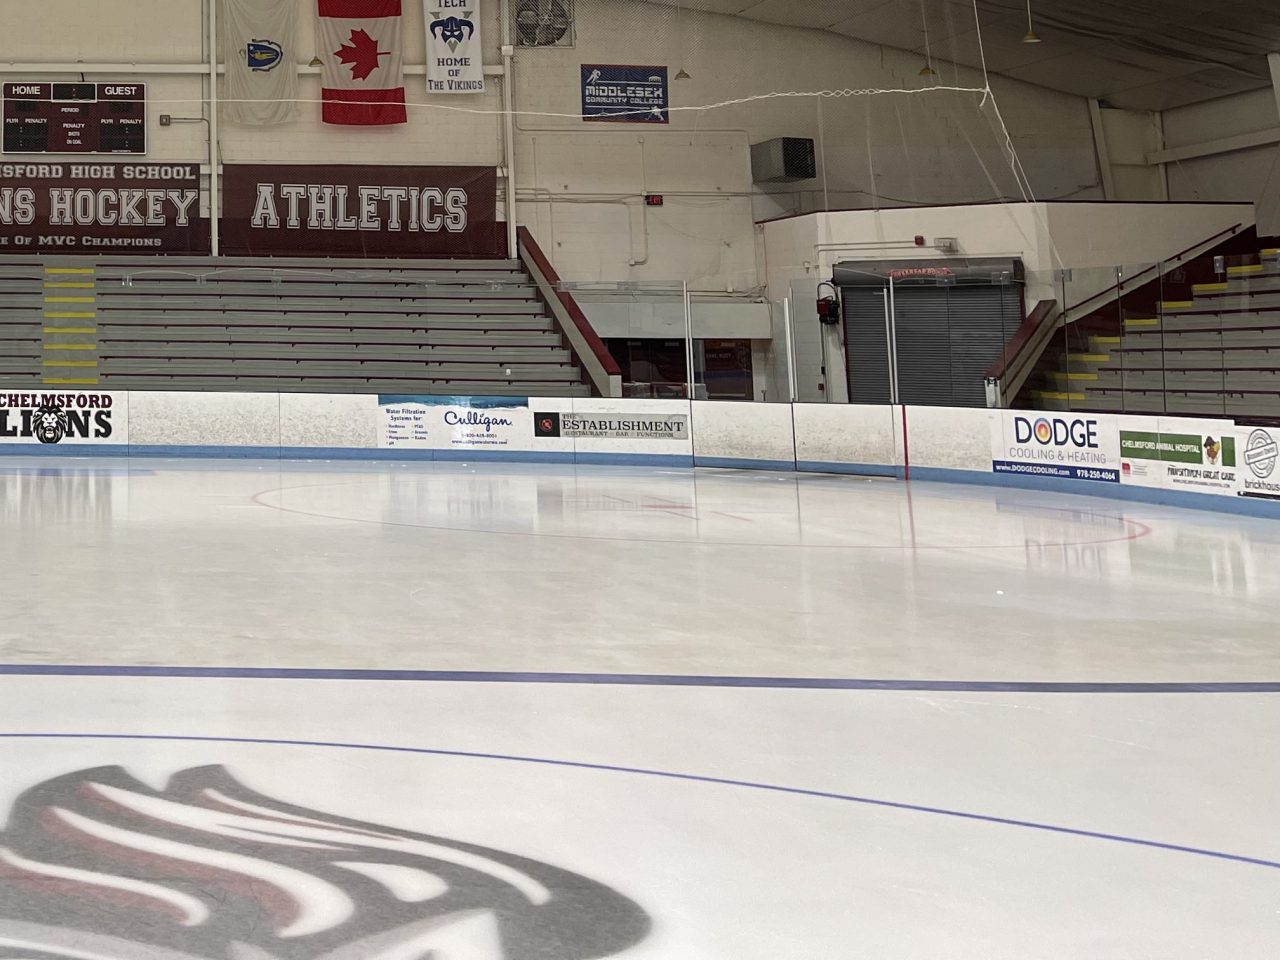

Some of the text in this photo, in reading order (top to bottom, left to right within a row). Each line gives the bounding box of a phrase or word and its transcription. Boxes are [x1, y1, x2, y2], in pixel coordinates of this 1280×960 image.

[437, 57, 471, 67] HOME
[448, 69, 460, 77] OF
[12, 86, 41, 96] HOME
[105, 86, 137, 96] GUEST
[70, 165, 116, 179] HIGH
[122, 166, 197, 180] SCHOOL
[49, 187, 199, 227] HOCKEY
[251, 183, 468, 232] ATHLETICS
[14, 235, 32, 245] OF
[38, 235, 76, 246] MVC
[82, 235, 163, 247] CHAMPIONS
[390, 415, 413, 423] Systems
[563, 419, 685, 433] ESTABLISHMENT
[1014, 417, 1099, 449] DODGE
[1122, 440, 1201, 454] CHELMSFORD ANIMAL HOSPITAL
[1009, 447, 1107, 465] COOLING & HEATING
[996, 464, 1116, 481] www.DODGECOOLING.com 978-250-4064
